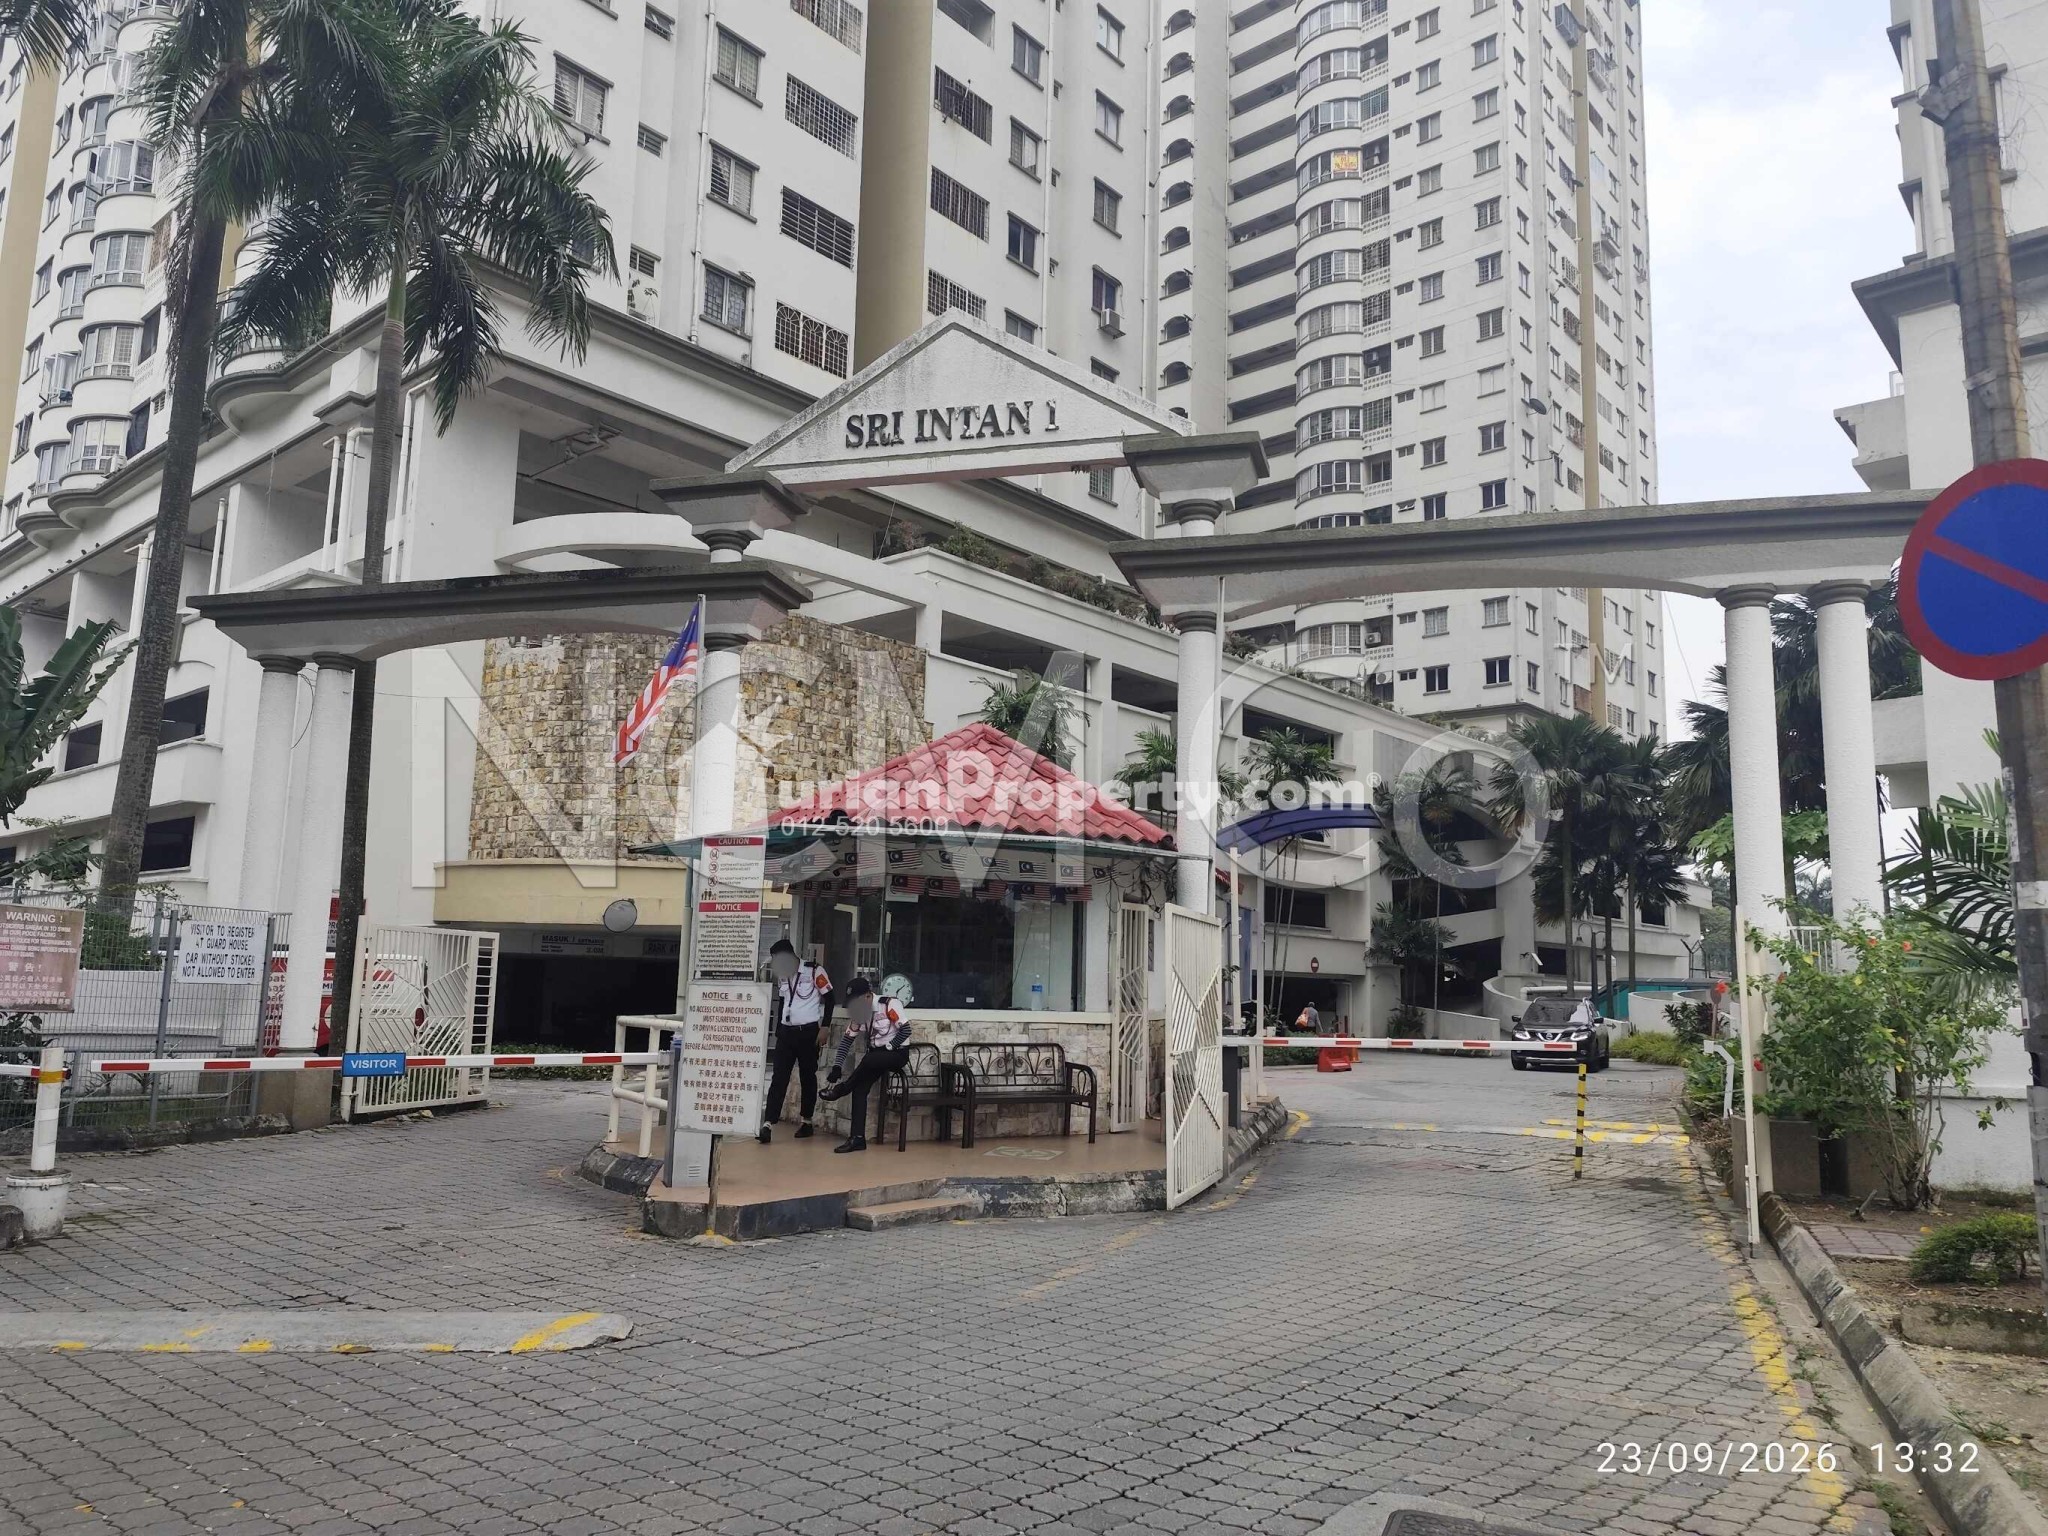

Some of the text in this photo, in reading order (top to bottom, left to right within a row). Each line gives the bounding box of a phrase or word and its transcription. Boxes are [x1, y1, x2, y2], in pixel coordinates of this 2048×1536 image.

[845, 411, 904, 449] SRI
[915, 401, 1033, 443] INTAN
[718, 837, 749, 845] CAUTION
[715, 903, 742, 911] NOTICE
[6, 911, 56, 923] WARNING
[191, 924, 255, 938] VISITOR TO REGISTER
[206, 938, 226, 950] GUARD
[229, 939, 248, 951] HOUSE
[542, 935, 569, 943] MASUK
[186, 952, 255, 965] CAR WITHOUT STICKER
[182, 966, 255, 978] NOT ALLOWED TO ENTER
[700, 1024, 716, 1032] DRIVING
[351, 1059, 397, 1068] VISITOR
